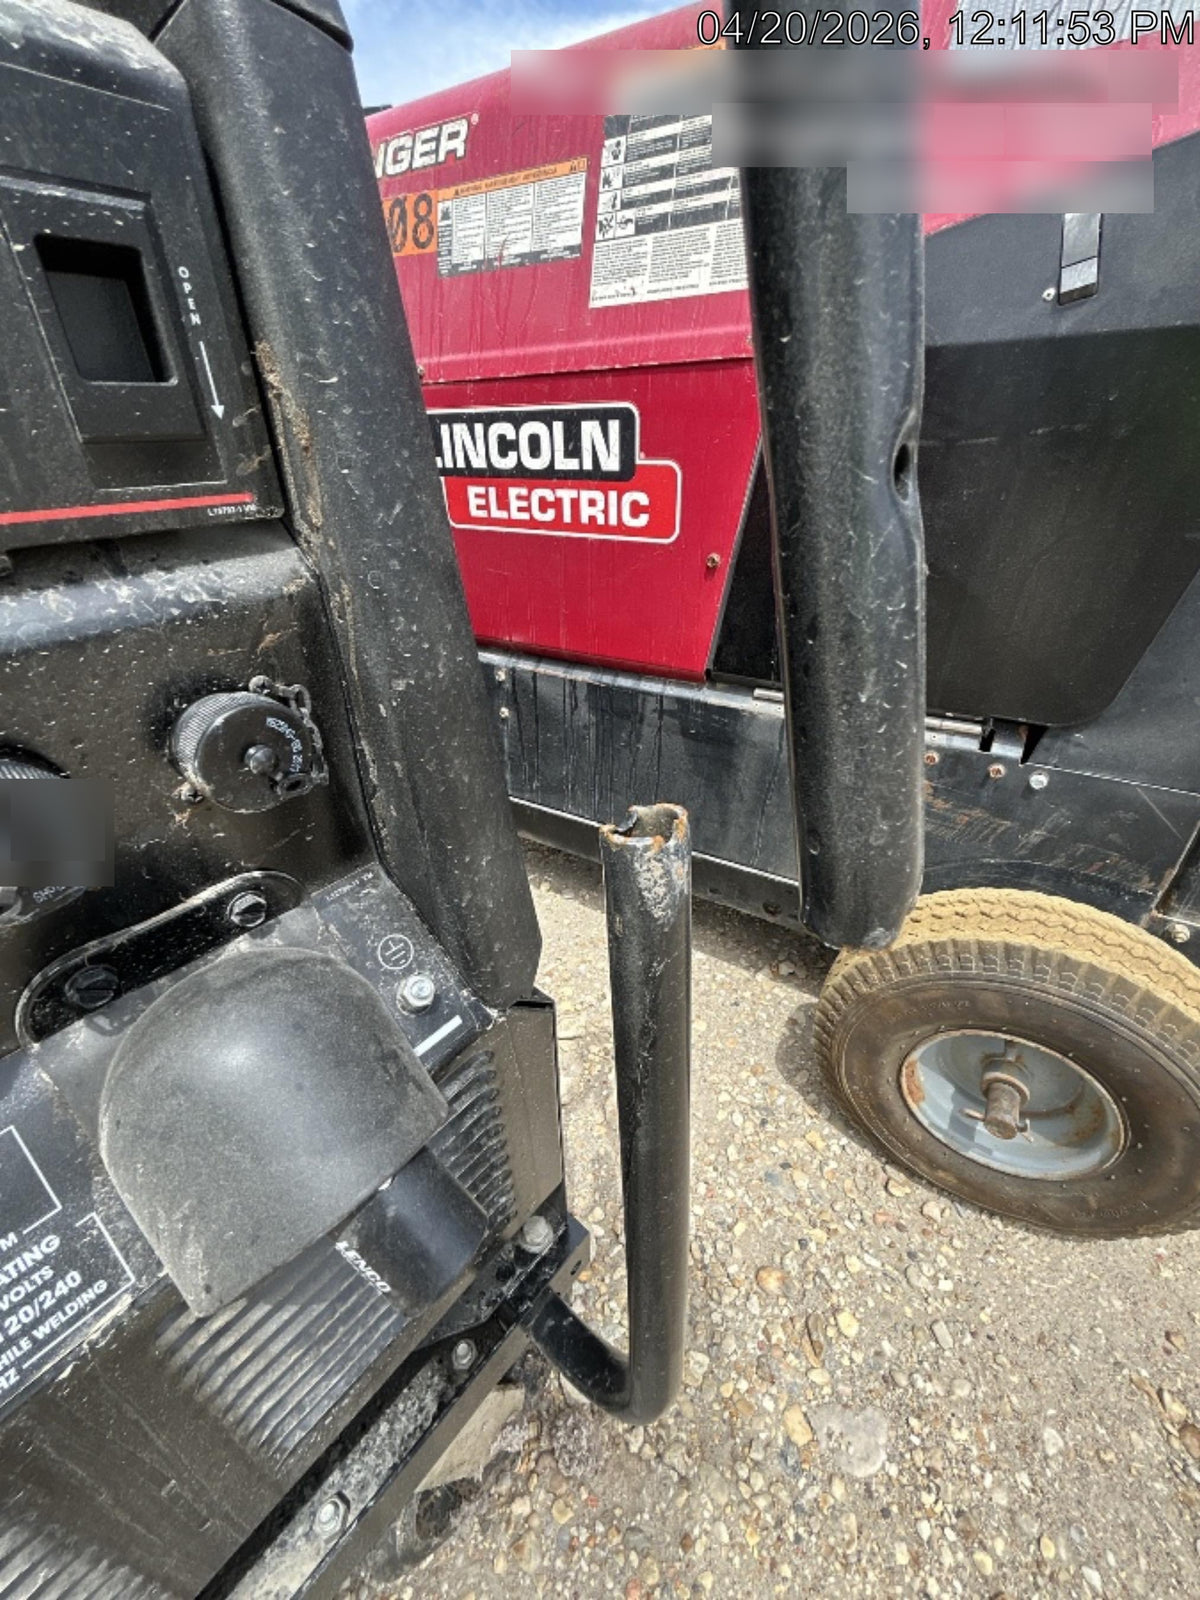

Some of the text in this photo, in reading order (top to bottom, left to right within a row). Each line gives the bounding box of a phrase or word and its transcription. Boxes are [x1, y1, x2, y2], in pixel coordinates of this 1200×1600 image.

[178, 266, 202, 327] OPEN
[435, 418, 620, 472] INCOLN
[466, 485, 650, 528] ELECTRIC
[0, 1265, 55, 1311] VOLTS
[335, 1241, 392, 1293] LENCO
[31, 1279, 108, 1339] WELDING
